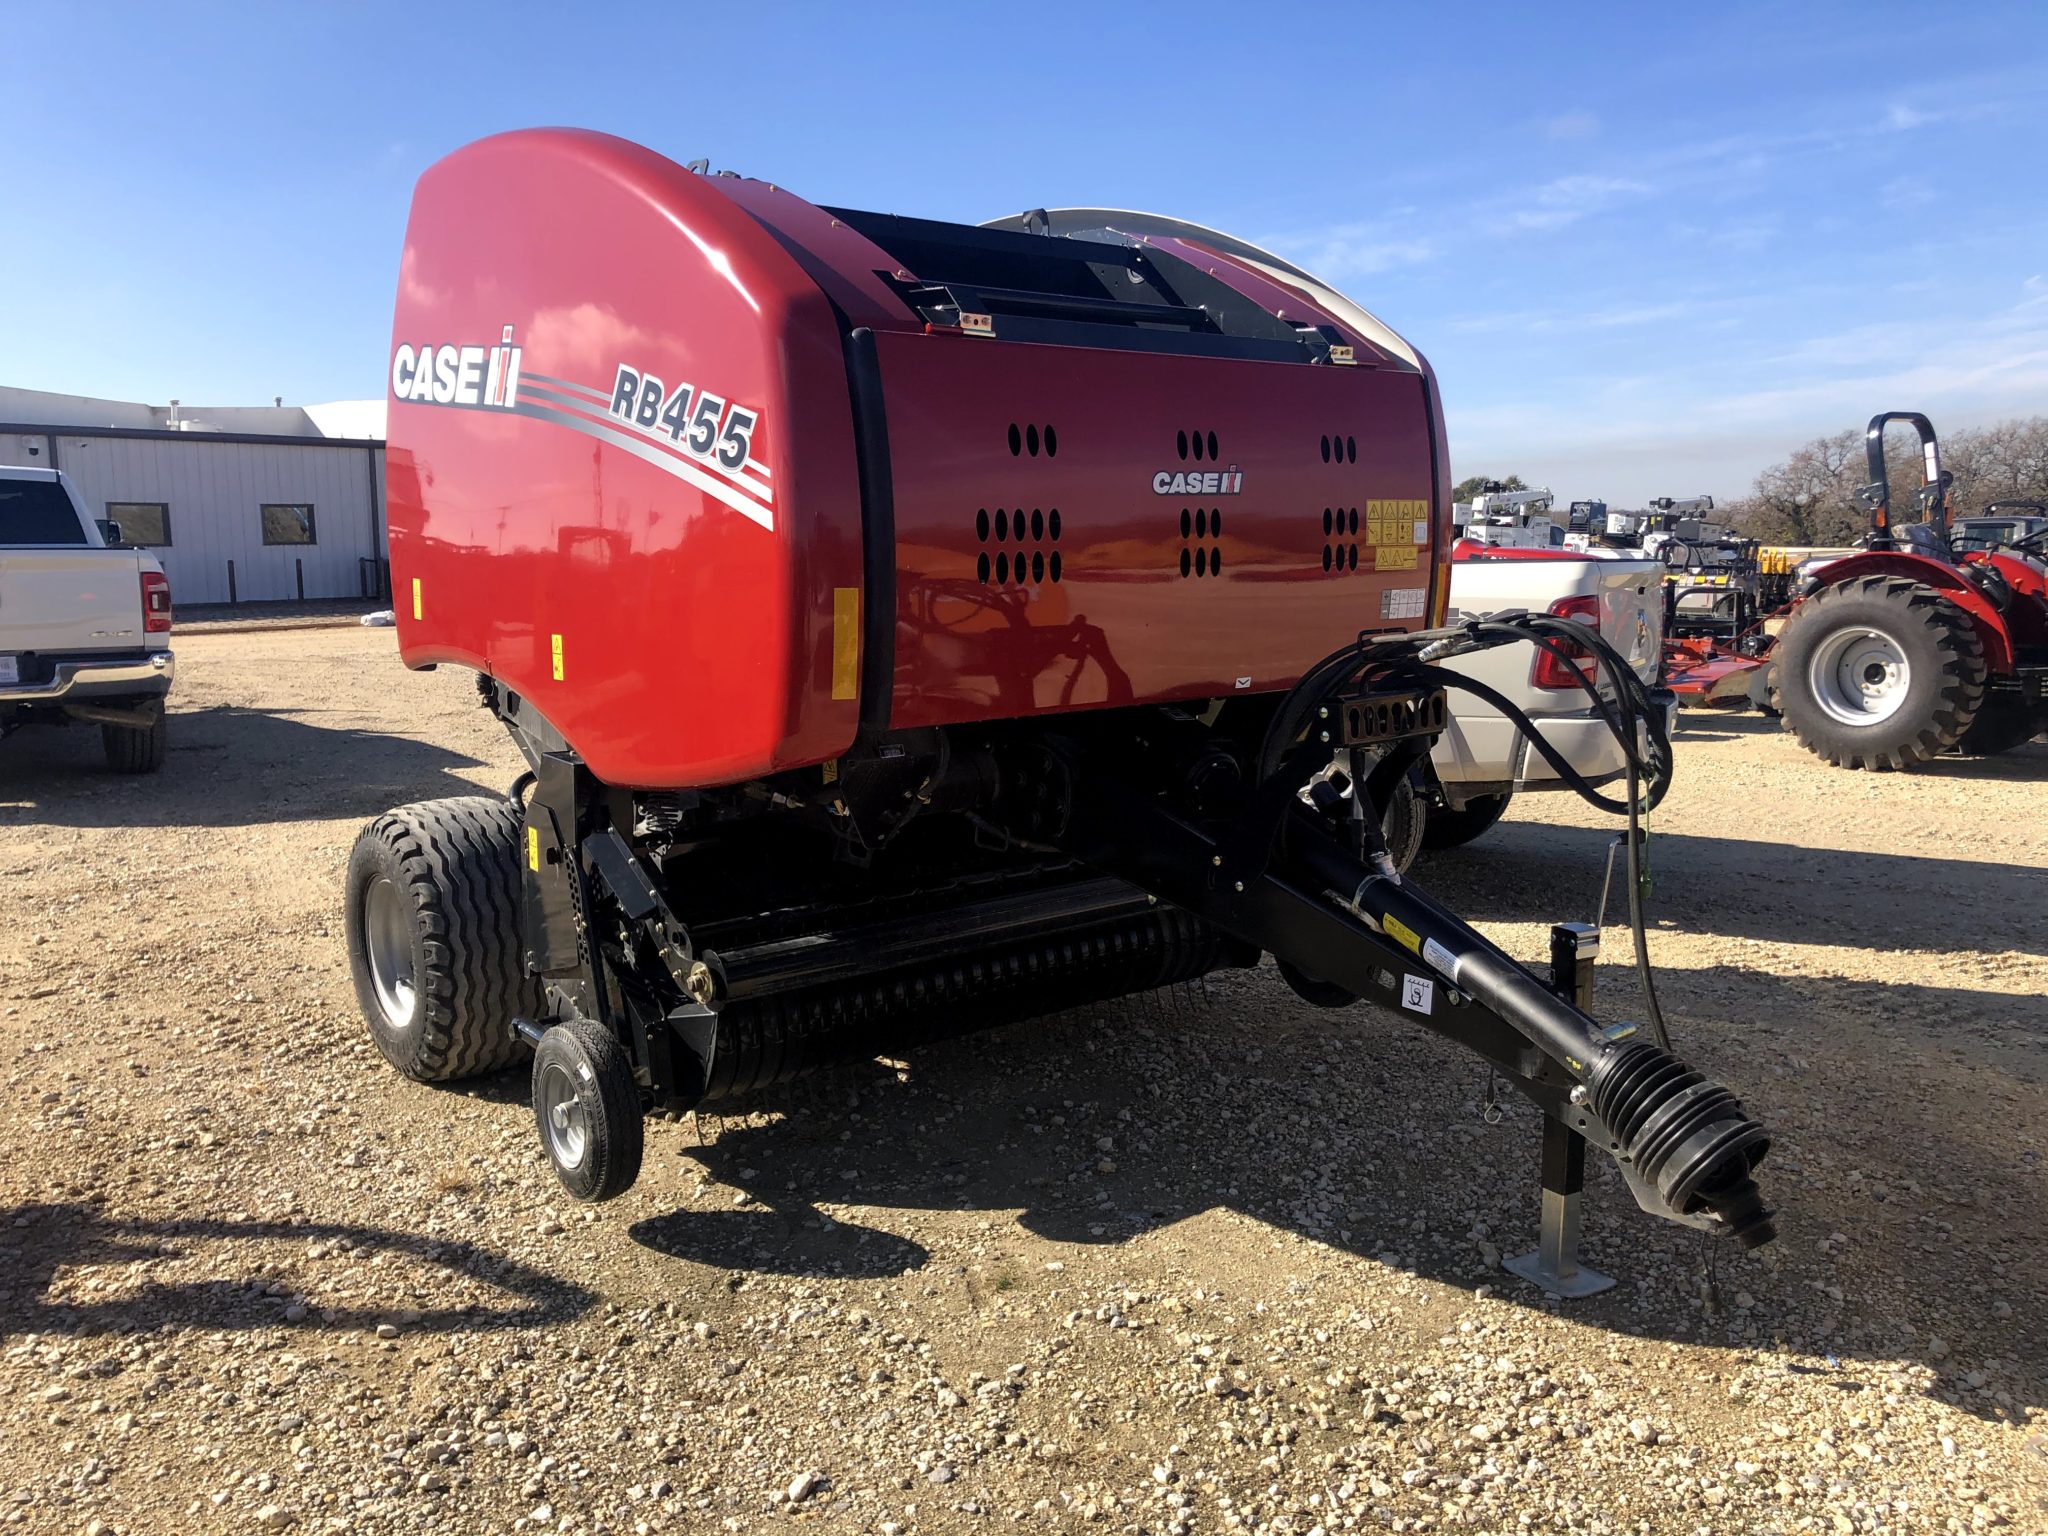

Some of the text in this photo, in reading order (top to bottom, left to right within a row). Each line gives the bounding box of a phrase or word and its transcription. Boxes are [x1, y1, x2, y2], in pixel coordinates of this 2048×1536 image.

[393, 344, 484, 403] CASE
[609, 363, 759, 473] RB455
[1153, 472, 1219, 494] CASE
